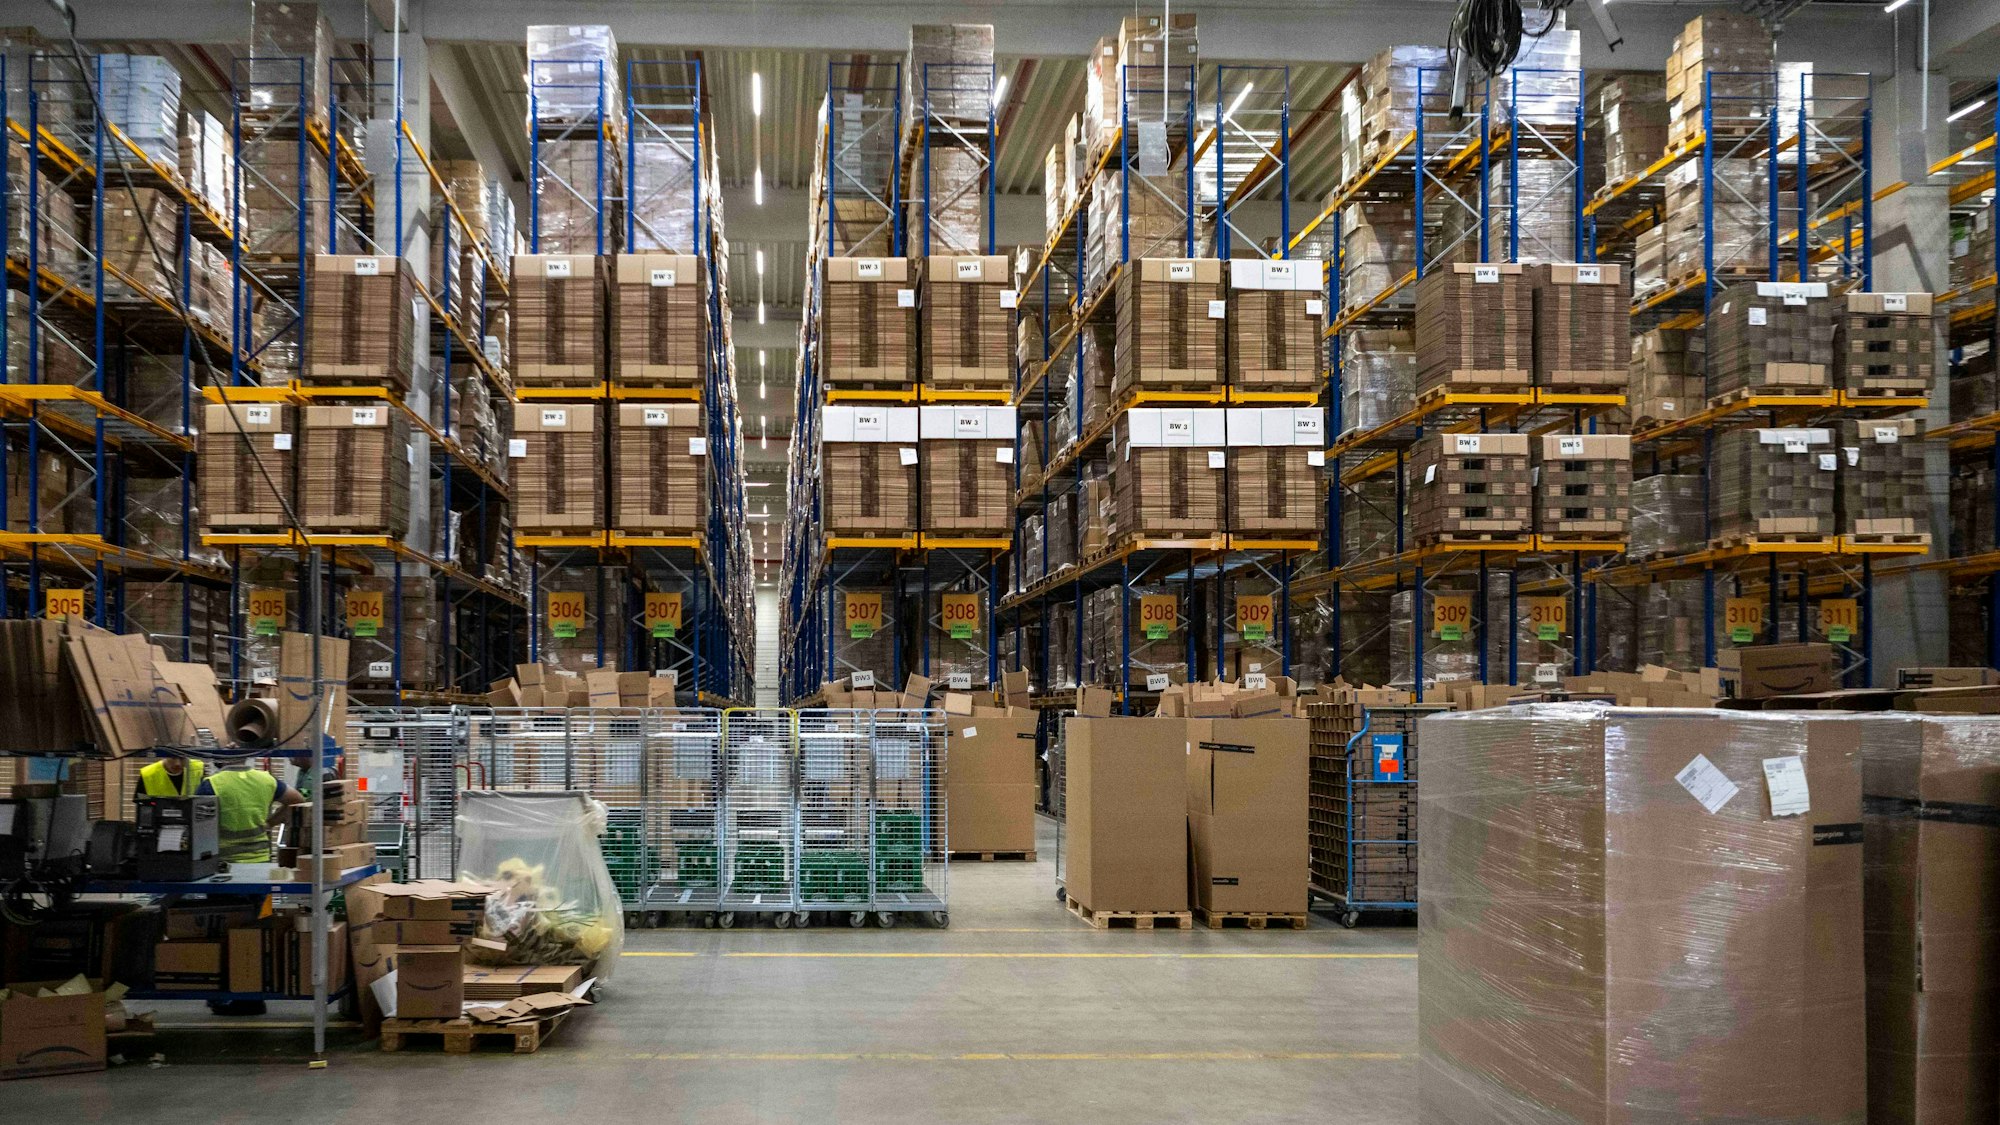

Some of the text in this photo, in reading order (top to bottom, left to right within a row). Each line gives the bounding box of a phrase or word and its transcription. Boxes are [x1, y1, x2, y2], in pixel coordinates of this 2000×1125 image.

[49, 598, 81, 615] 305
[252, 600, 283, 616] 305
[351, 600, 380, 617] 306
[551, 601, 581, 618] 306
[647, 602, 679, 618] 307
[849, 603, 880, 619] 307
[944, 603, 976, 620] 308
[1143, 604, 1174, 620] 308
[1239, 604, 1269, 621] 309
[1437, 605, 1467, 622] 309
[1533, 606, 1563, 622] 310
[1728, 607, 1759, 623] 310
[1823, 608, 1852, 624] 311
[855, 674, 871, 682] BW3
